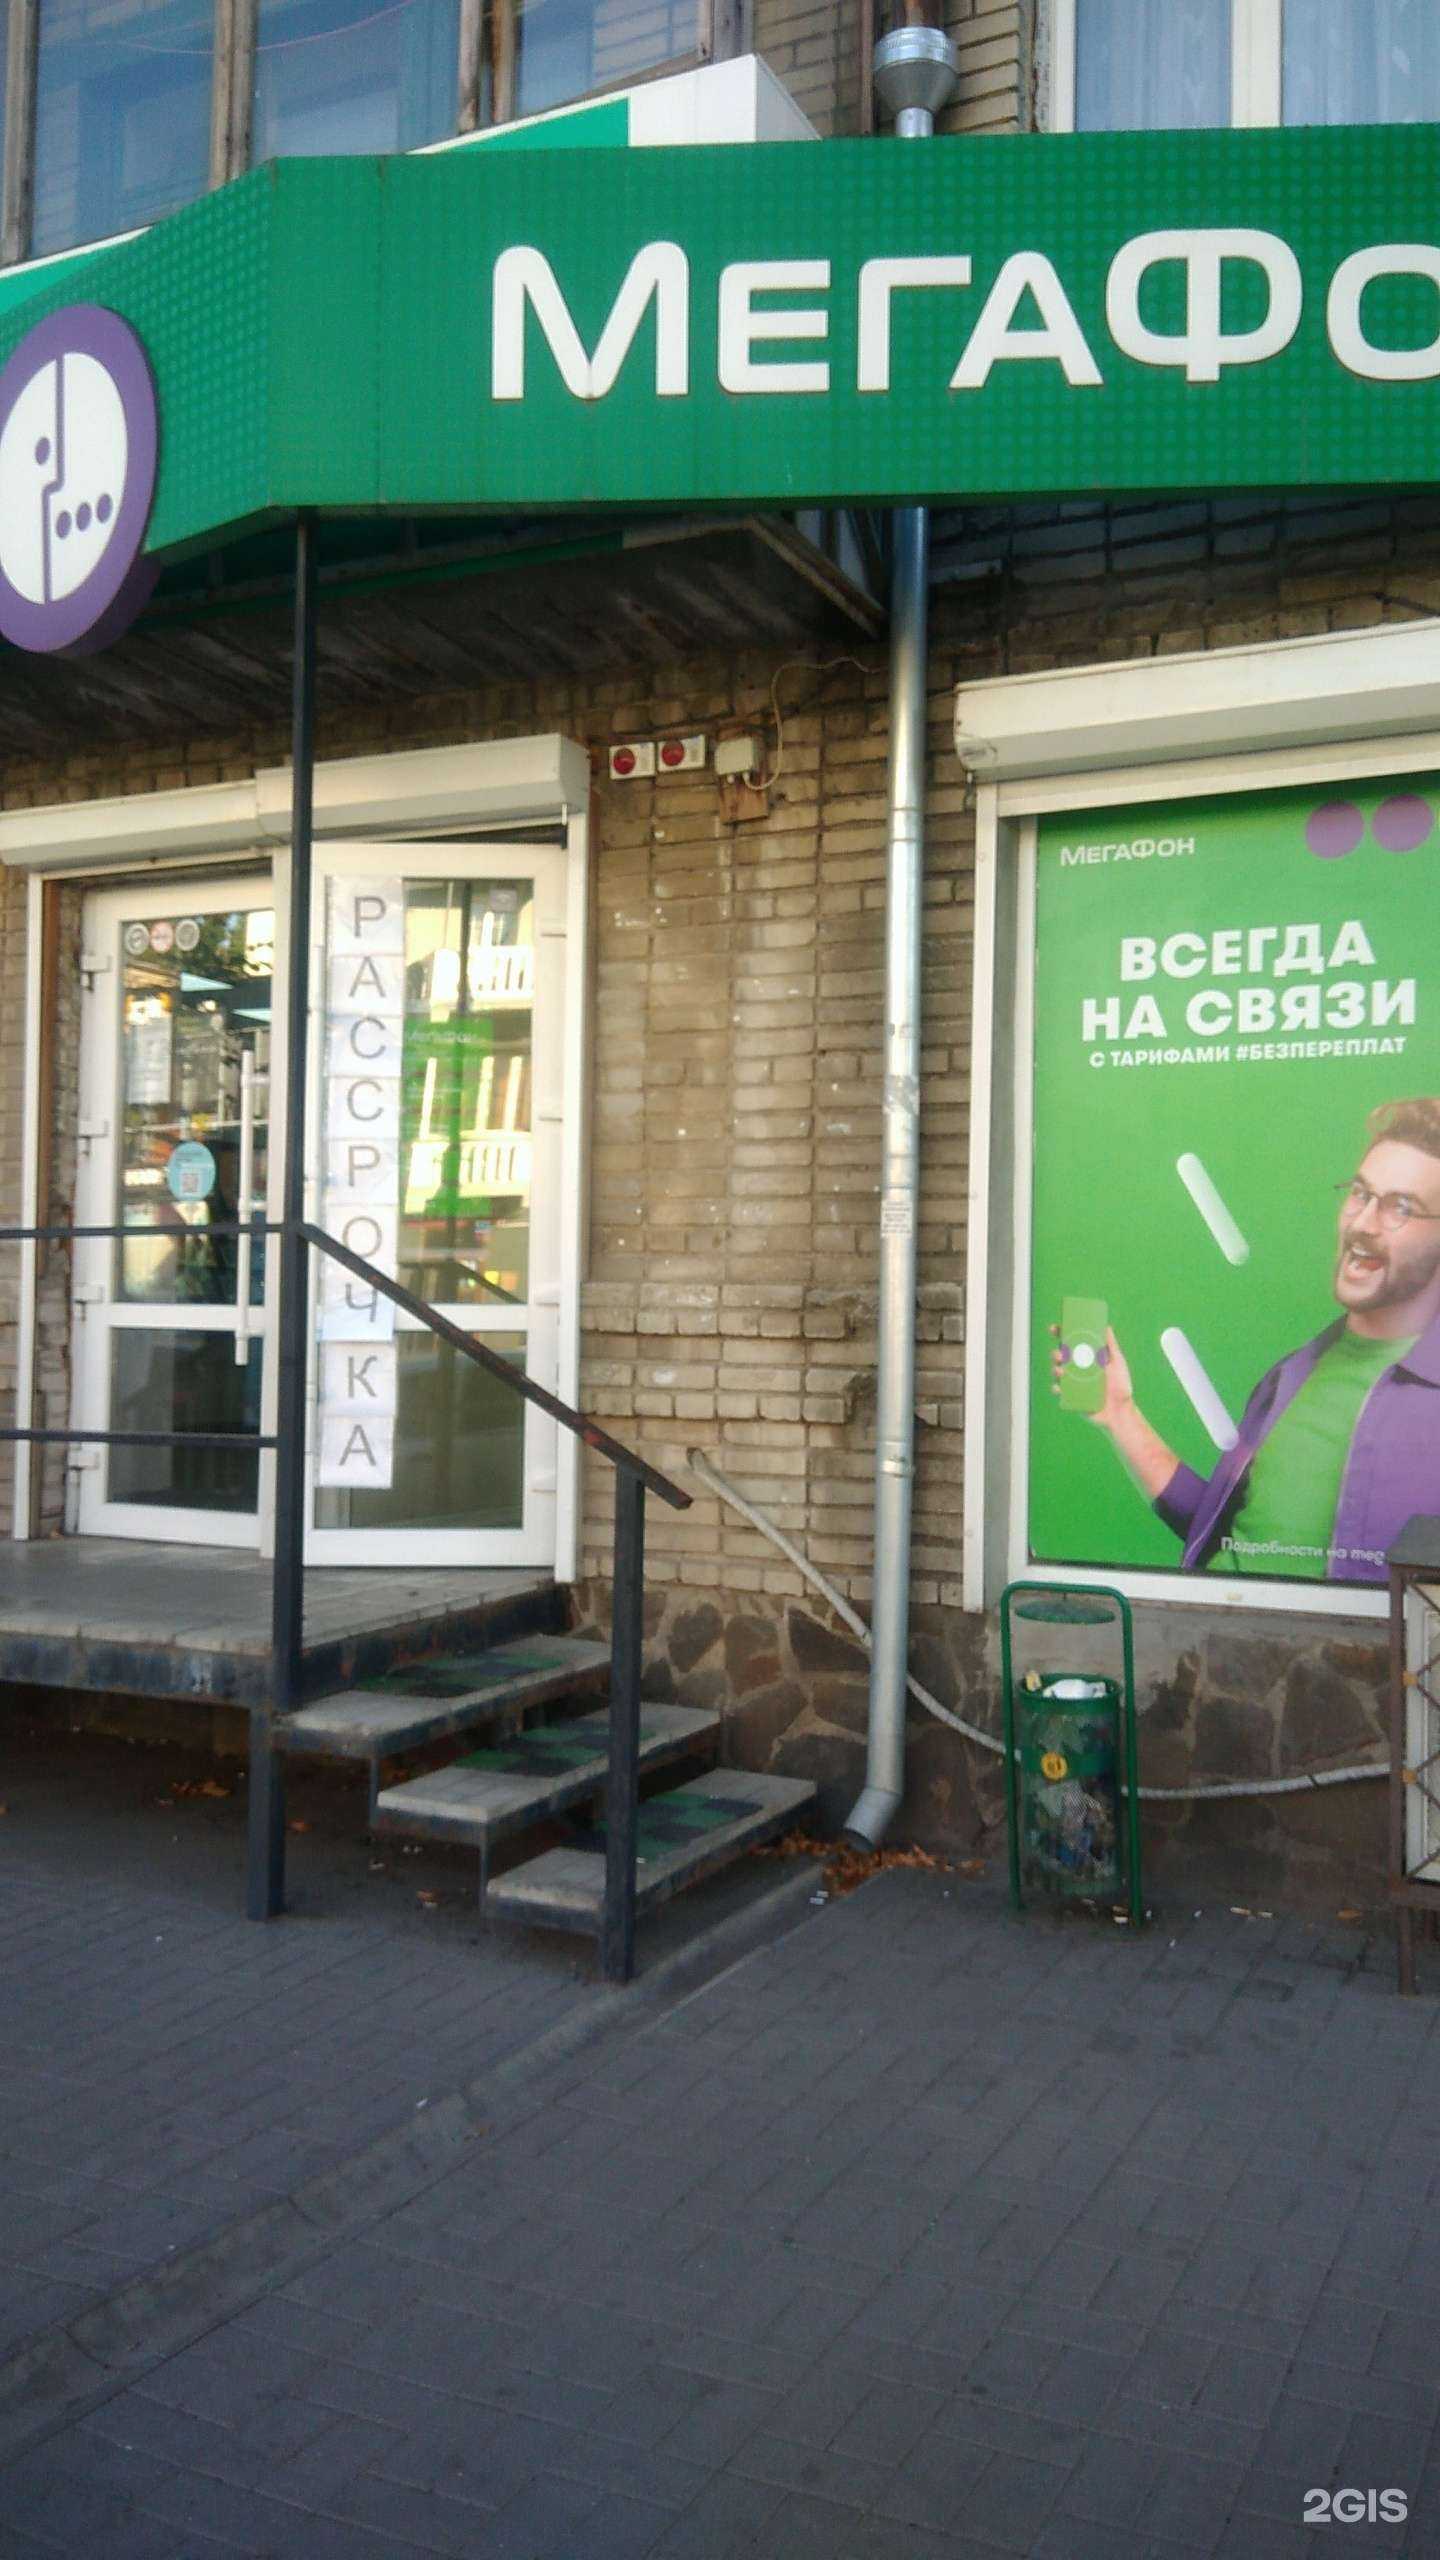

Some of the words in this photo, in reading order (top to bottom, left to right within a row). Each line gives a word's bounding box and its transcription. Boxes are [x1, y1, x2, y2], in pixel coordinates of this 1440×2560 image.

[1060, 838, 1195, 866] МЕГАФОН
[1120, 921, 1376, 982] ВСЕГДА
[1082, 995, 1168, 1042] НА
[1185, 979, 1417, 1036] СВЯЗИ
[1089, 1051, 1106, 1069] С
[1110, 1046, 1230, 1067] ТАРИФАМИ
[1236, 1036, 1408, 1062] #БЕЗПЕРЕПЛАТ
[338, 896, 388, 1469] РАССРОЧКА
[1220, 1536, 1323, 1556] Подробности
